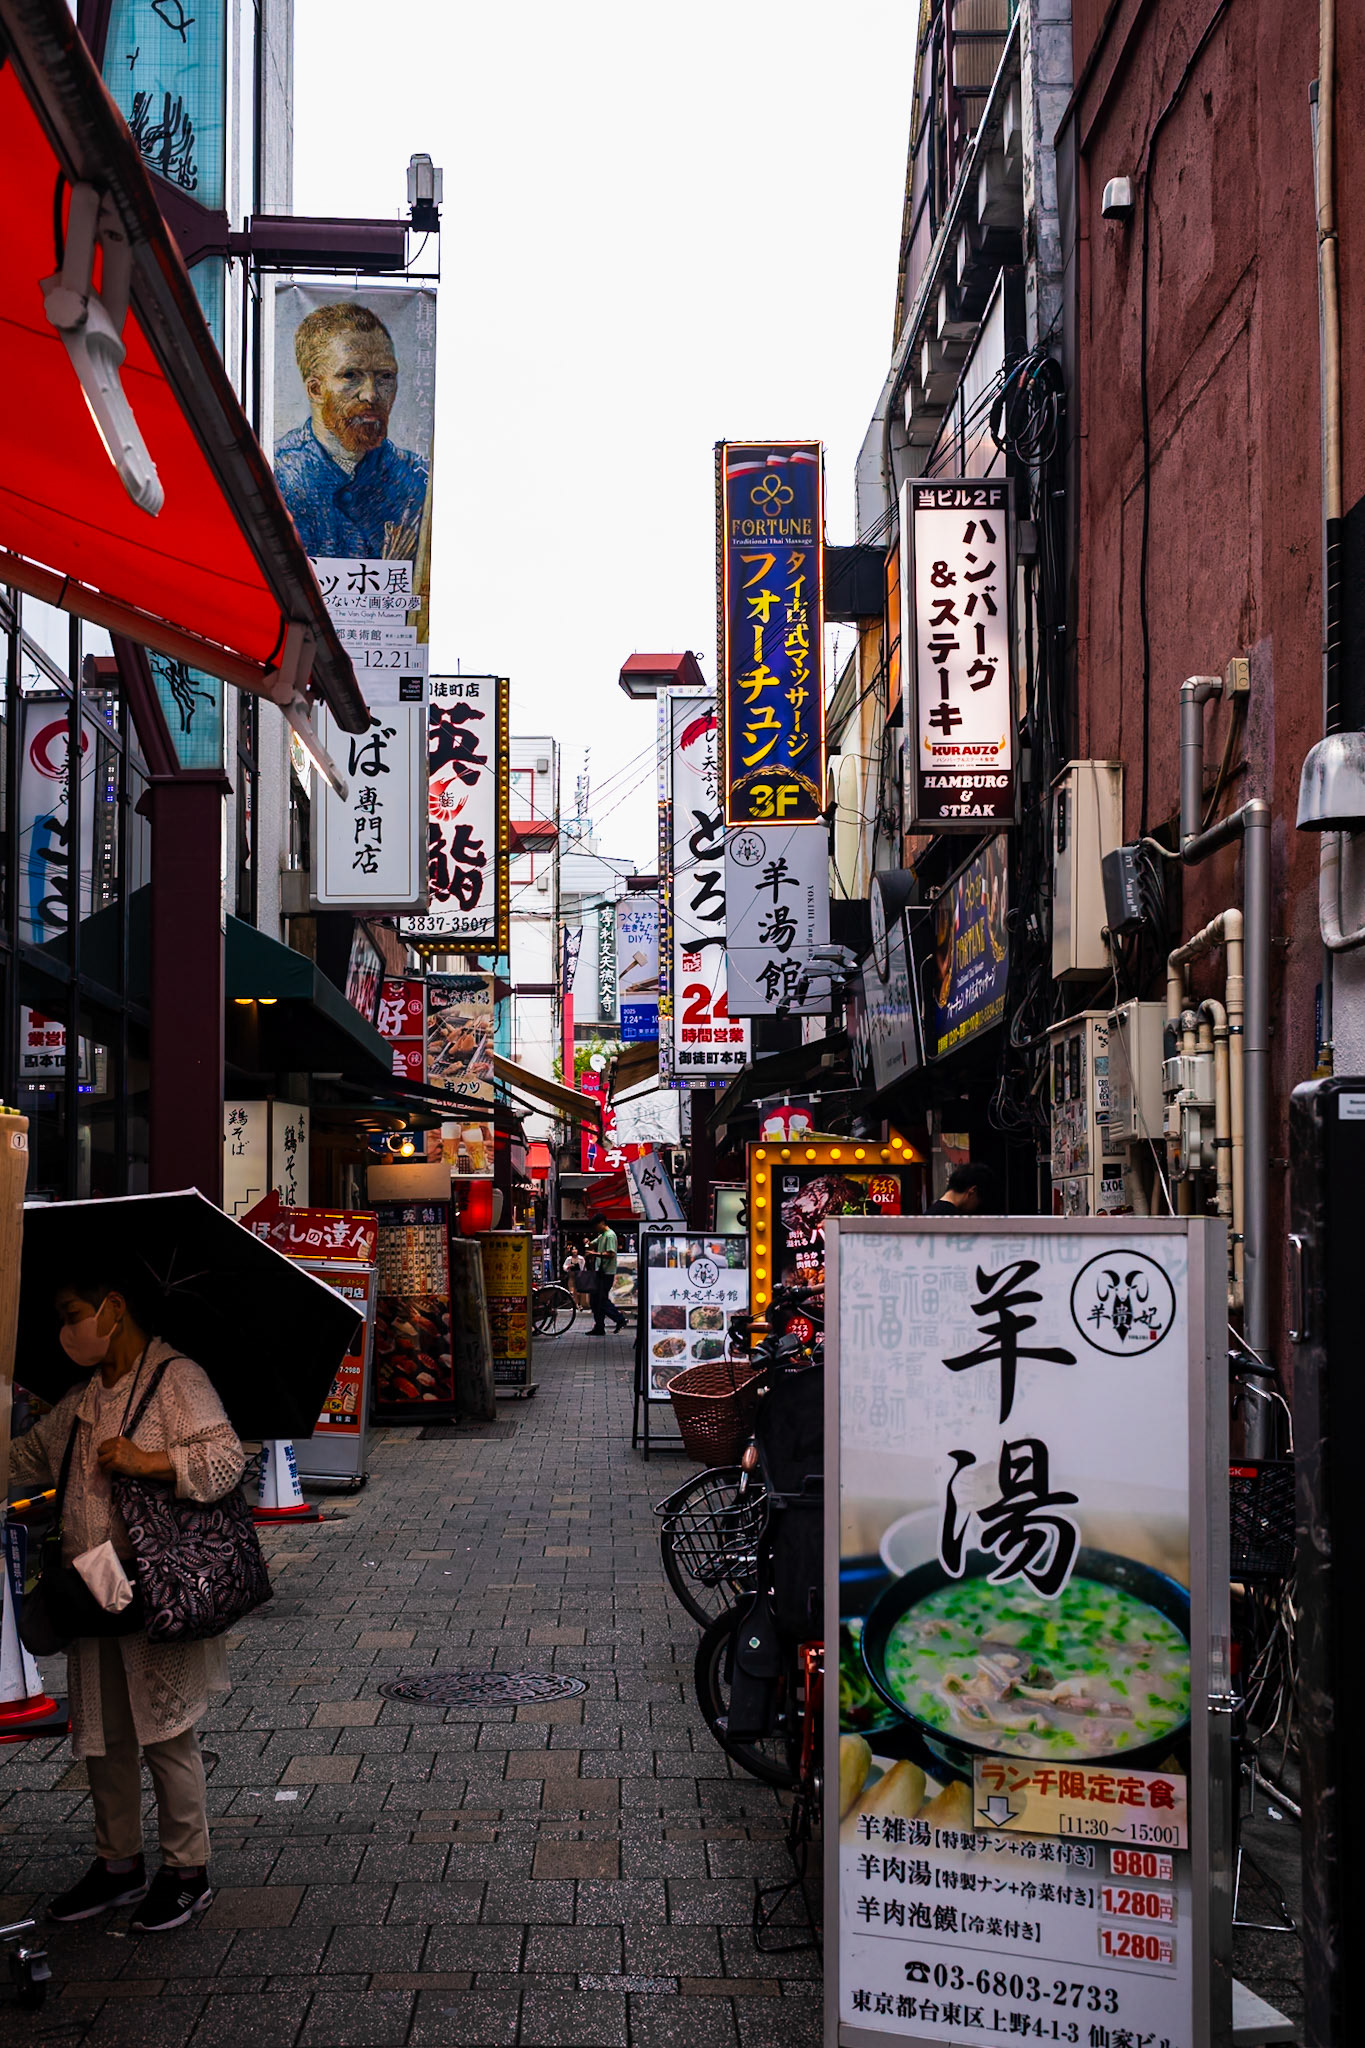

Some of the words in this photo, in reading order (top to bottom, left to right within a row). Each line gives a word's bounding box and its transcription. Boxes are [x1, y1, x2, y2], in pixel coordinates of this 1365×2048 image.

[918, 489, 1002, 508] 当ビル2F
[732, 519, 811, 535] FORTUNE
[312, 558, 411, 596] ッホ展
[962, 519, 998, 692] ハンバーグ
[784, 551, 809, 757] タイ古式マッサージ
[928, 560, 963, 736] &ステーキ
[740, 552, 781, 767] フォーチュン
[429, 682, 480, 698] 徒町店
[932, 746, 999, 756] KURAUZO
[924, 775, 1009, 789] HAMBURG
[749, 784, 799, 818] 3F
[960, 790, 973, 802] &
[939, 803, 995, 818] STEAK
[408, 916, 488, 932] 3837-3507
[628, 935, 643, 943] DIY
[681, 1028, 744, 1043] 時間営業
[679, 1051, 747, 1065] 御徒町本店
[872, 1193, 894, 1203] OK!
[252, 1220, 368, 1250] ほぐしの達人
[942, 1260, 1080, 1596] 羊湯
[981, 1763, 1176, 1810] ランチ限定定食
[934, 1962, 1119, 2015] 03-6803-2733
